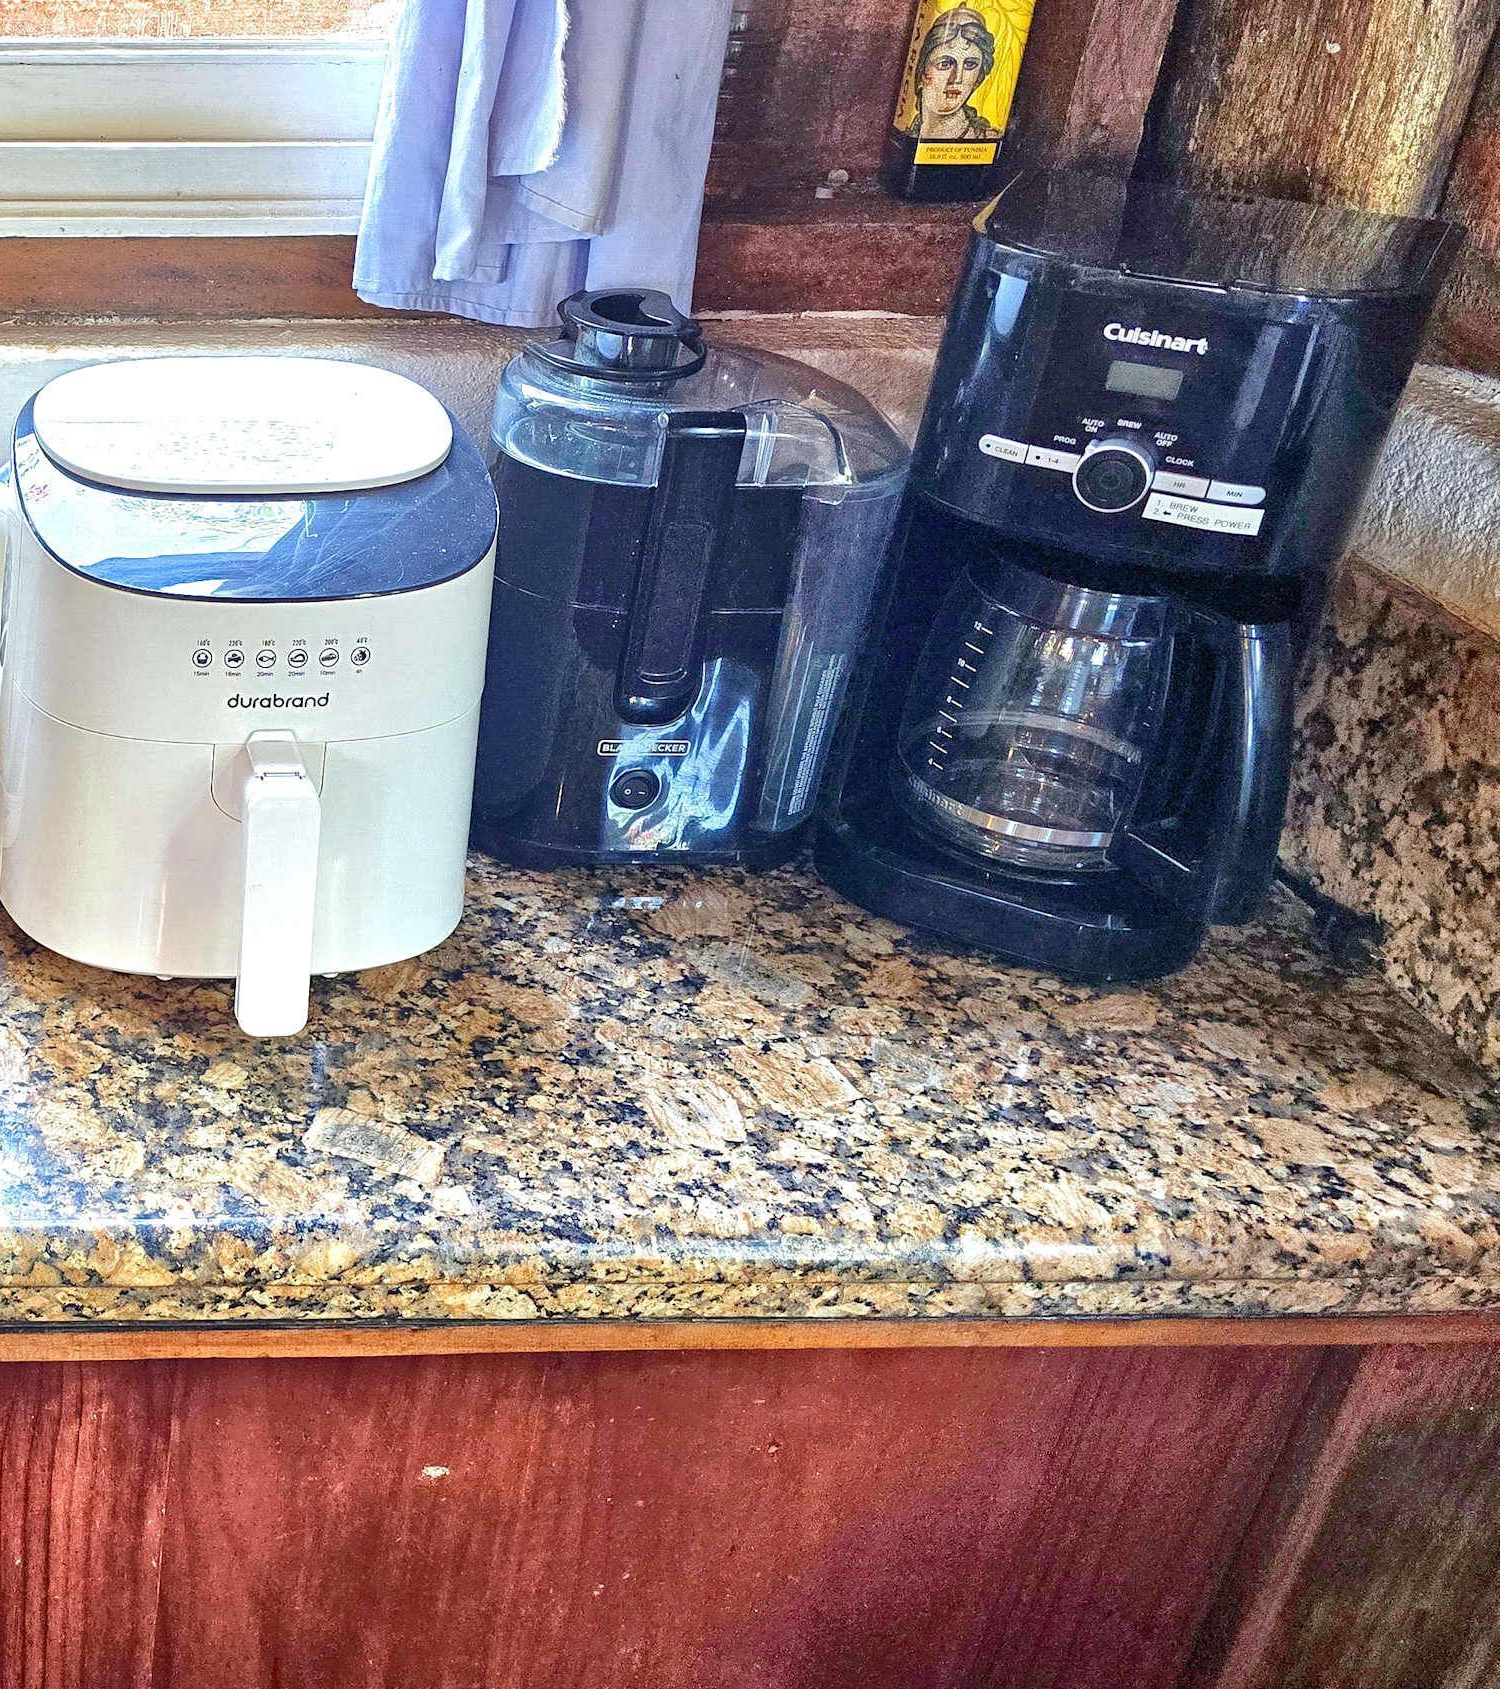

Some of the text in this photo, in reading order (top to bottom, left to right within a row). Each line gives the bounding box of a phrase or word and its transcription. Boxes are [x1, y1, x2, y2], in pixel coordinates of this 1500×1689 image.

[1103, 322, 1208, 356] Cuisinart
[1081, 417, 1105, 428] AUTO
[1117, 418, 1142, 430] BREW
[1084, 425, 1099, 433] ON
[1053, 434, 1077, 445] PROG
[1154, 431, 1178, 442] AUTO
[1155, 439, 1173, 448] OFF
[994, 446, 1019, 457] CLEAN
[1165, 456, 1195, 468] CLOCK
[1226, 490, 1243, 499] MIN
[1169, 501, 1200, 513] BREW
[1177, 512, 1210, 525] PRESS
[1214, 518, 1252, 530] POWER
[973, 621, 982, 631] 12
[227, 691, 329, 708] durabrand
